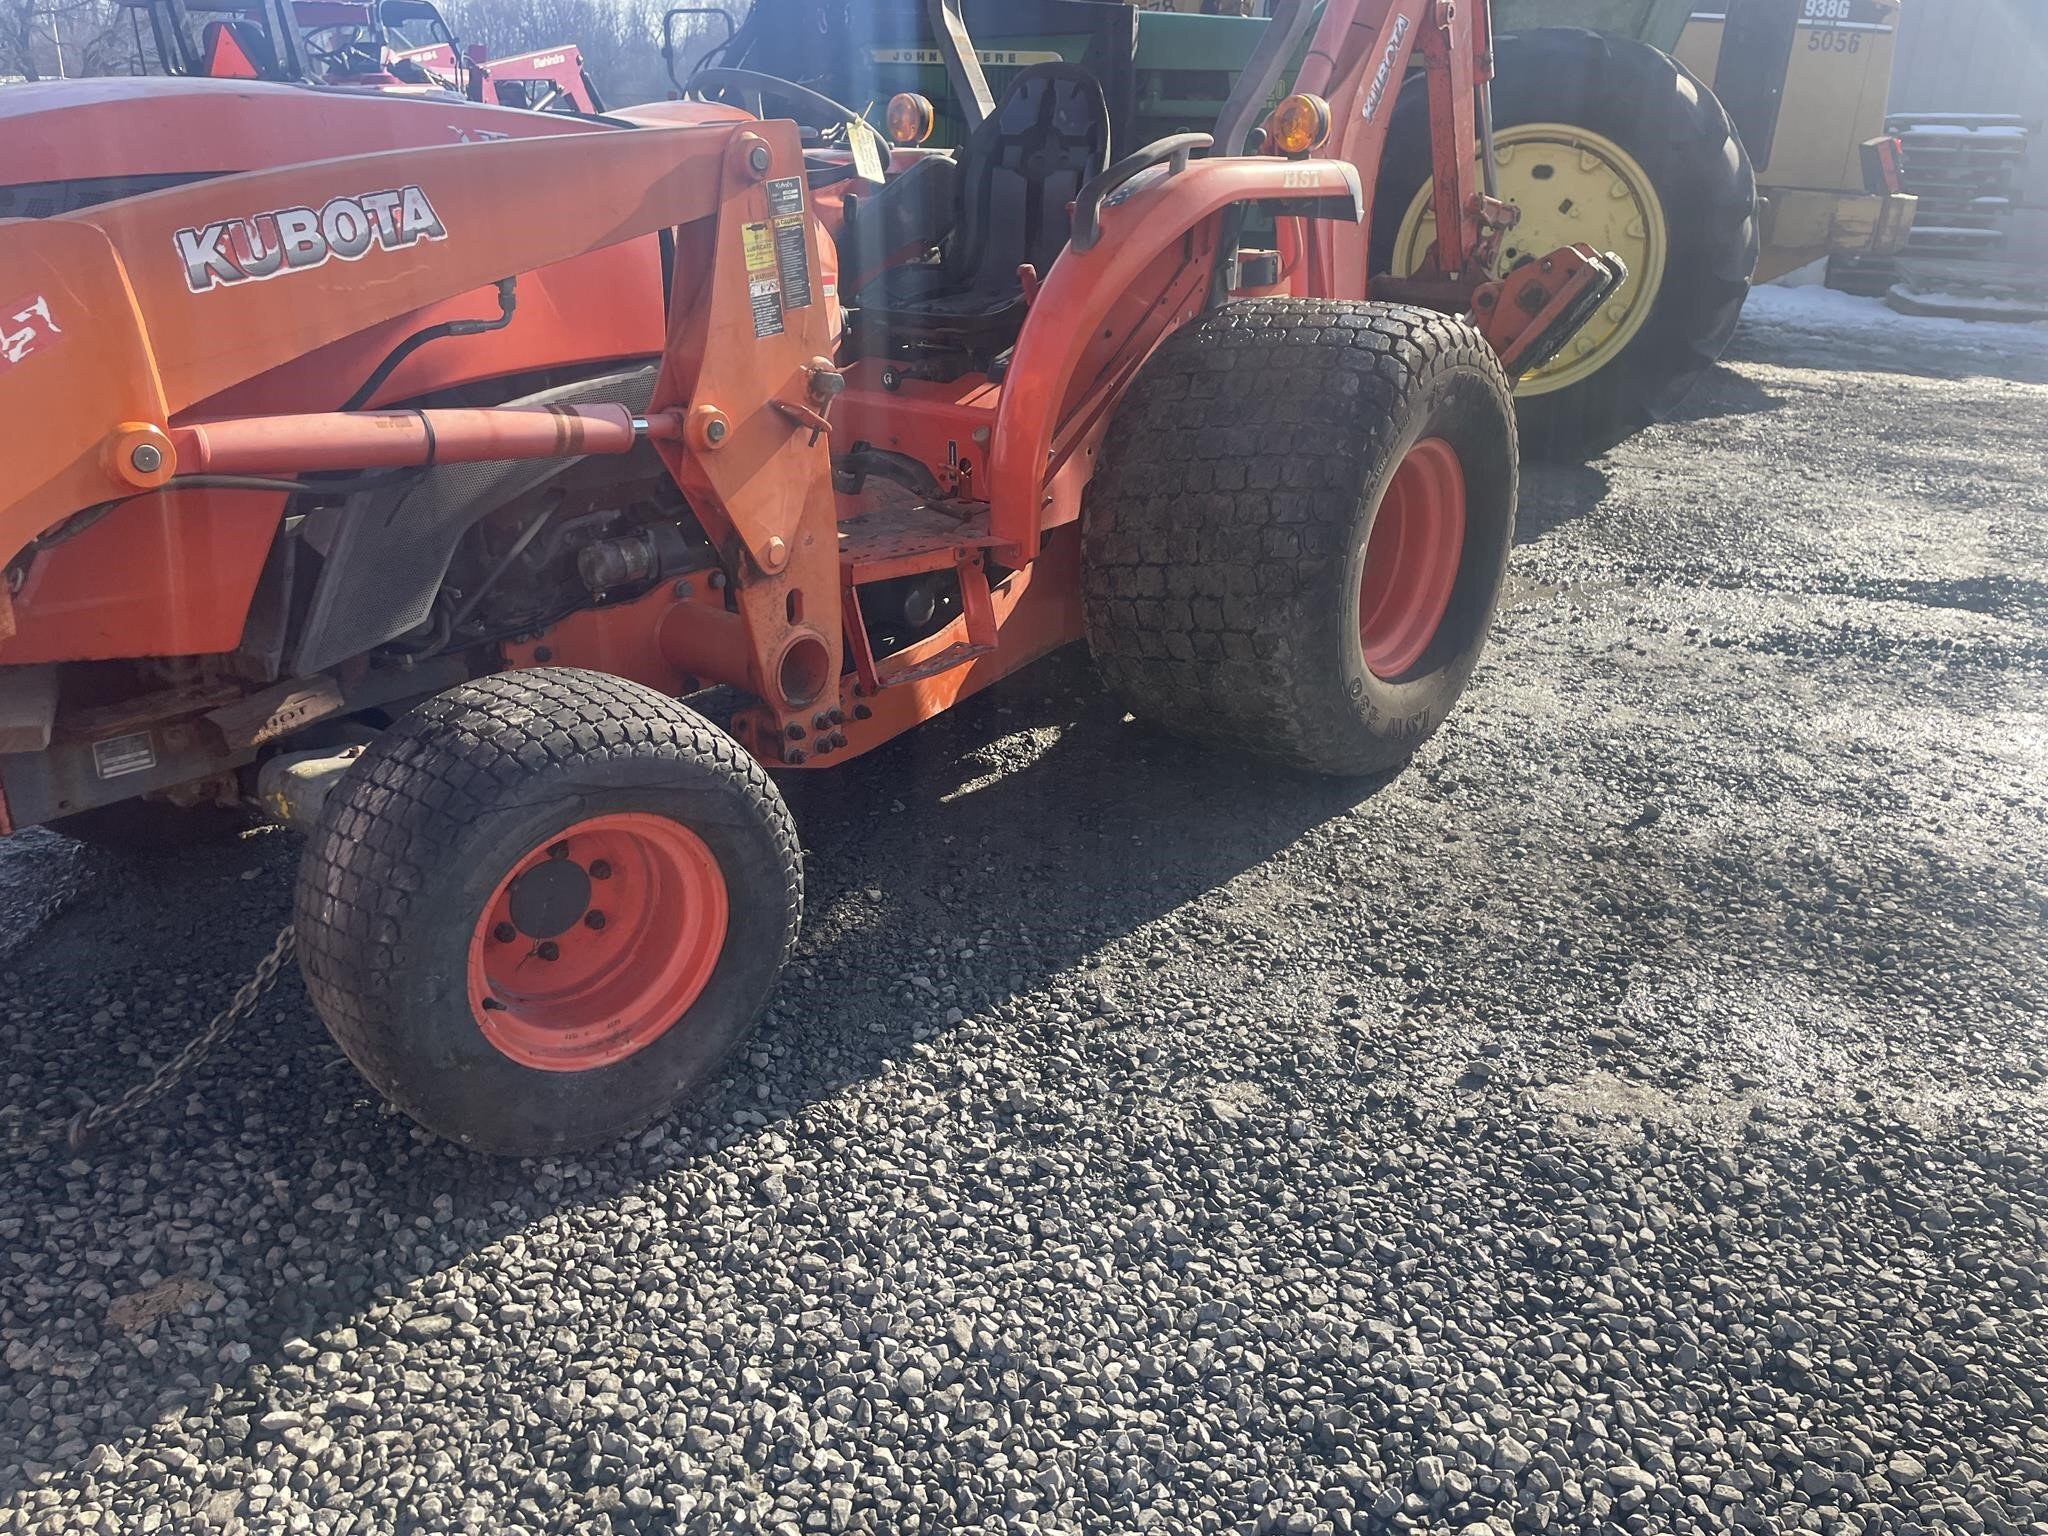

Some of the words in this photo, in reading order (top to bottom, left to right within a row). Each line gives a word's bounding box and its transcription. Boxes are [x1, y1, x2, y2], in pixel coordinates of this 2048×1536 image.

[1804, 0, 1851, 18] 938G
[1808, 31, 1862, 54] 5056
[892, 52, 938, 62] JOHN
[982, 53, 1017, 63] ERE
[174, 185, 447, 292] KUBOTA
